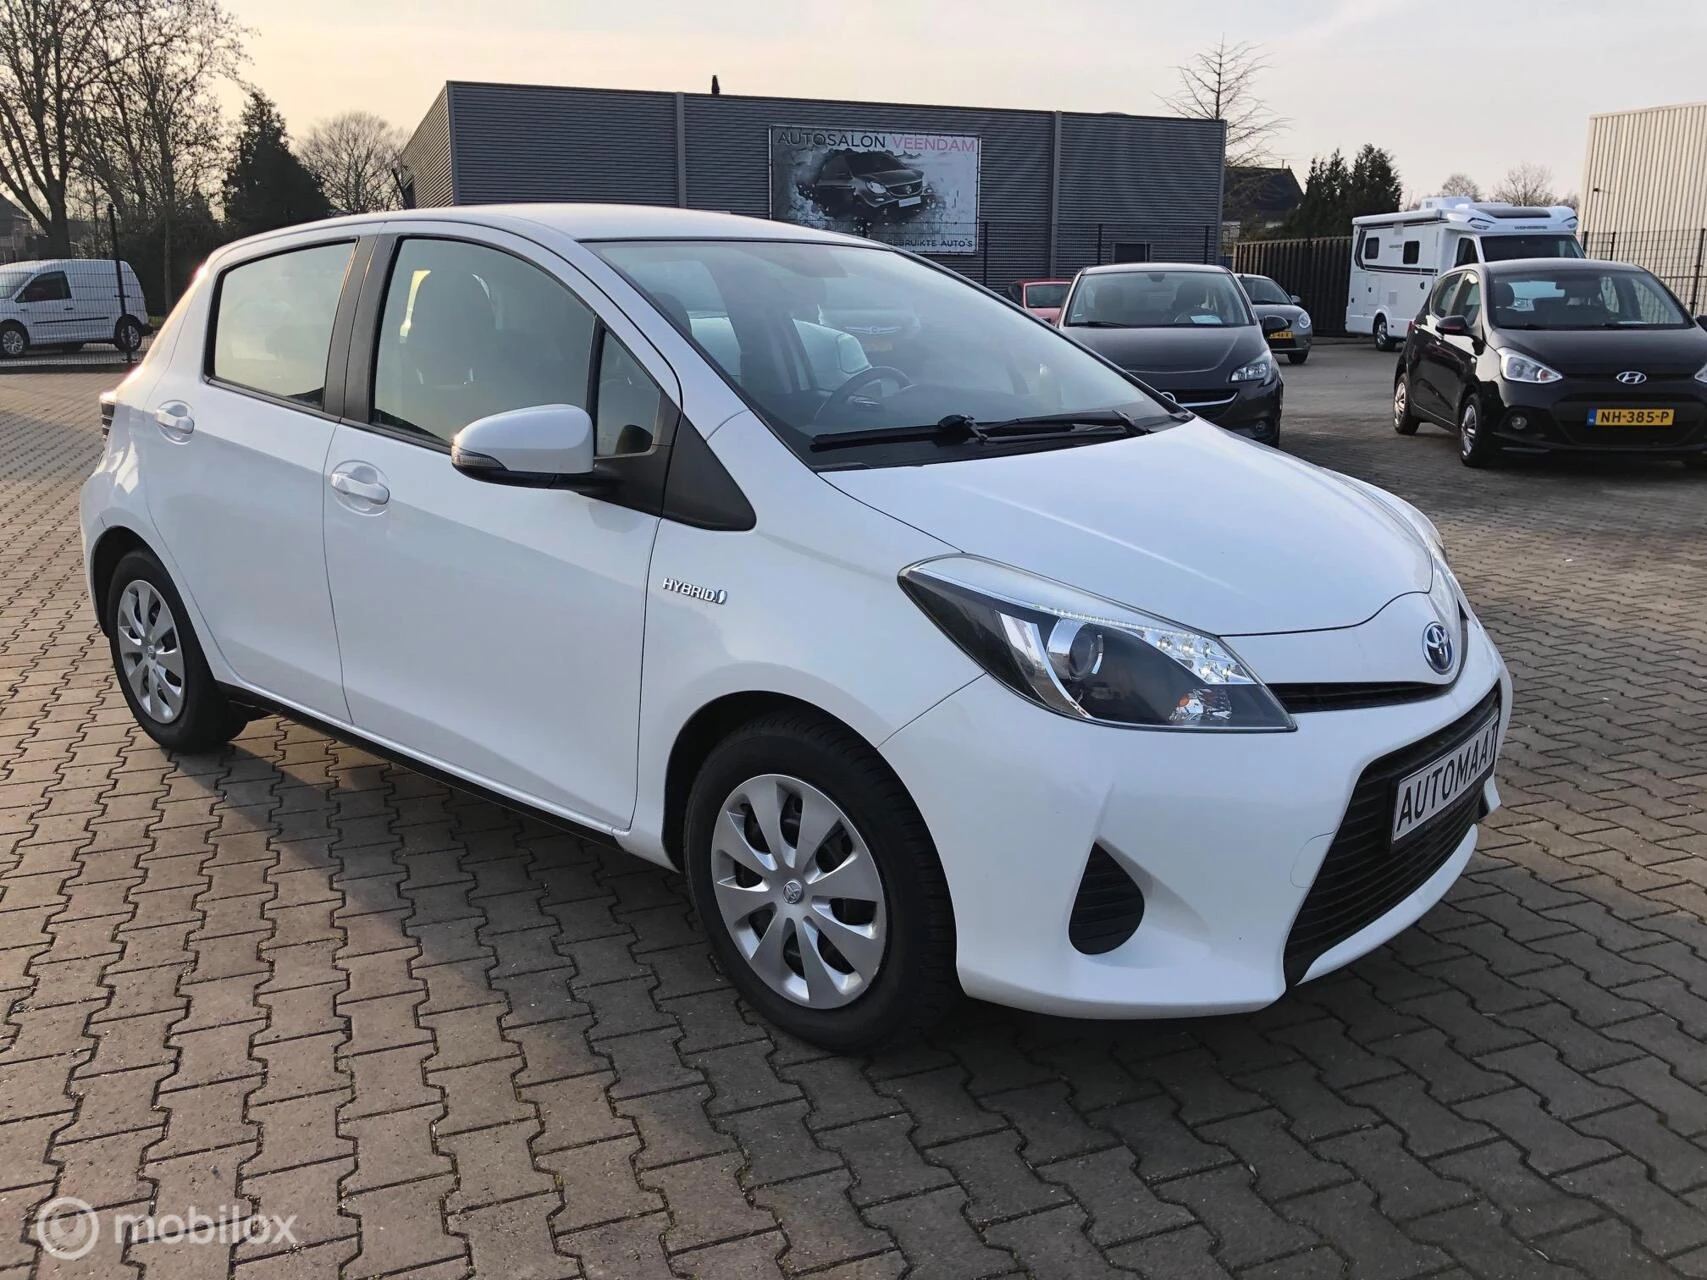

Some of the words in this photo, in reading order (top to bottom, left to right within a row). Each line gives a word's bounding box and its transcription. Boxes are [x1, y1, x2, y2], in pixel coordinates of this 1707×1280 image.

[777, 131, 886, 148] AUTOSALON
[893, 136, 975, 152] VEENDAM
[940, 238, 973, 248] AUTO'S
[1600, 411, 1670, 423] NH-385-P
[662, 577, 716, 602] HYBRID
[1396, 723, 1499, 832] AUTOMAAT
